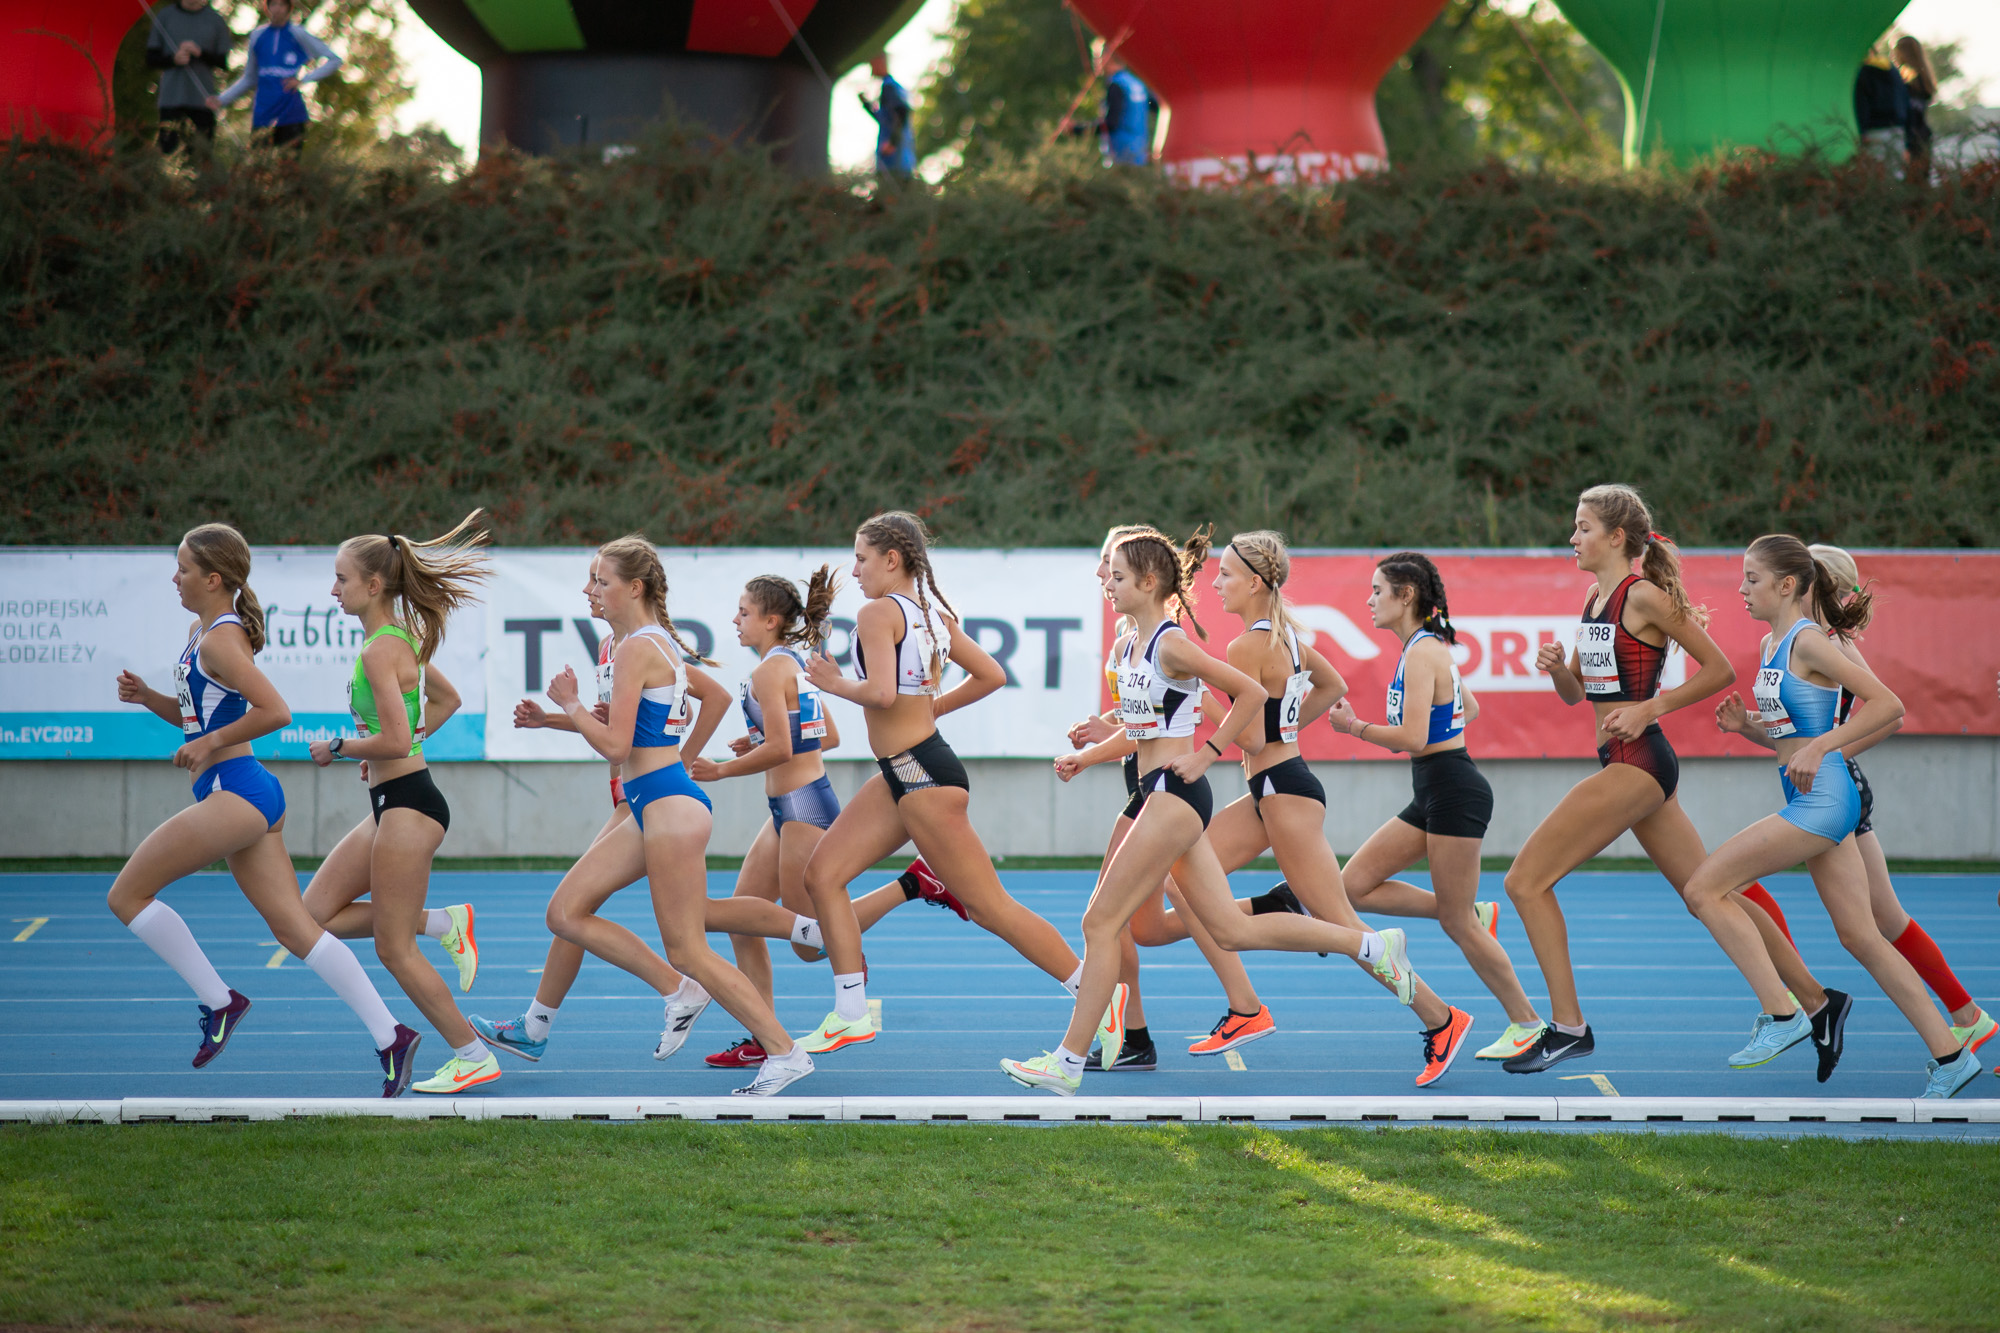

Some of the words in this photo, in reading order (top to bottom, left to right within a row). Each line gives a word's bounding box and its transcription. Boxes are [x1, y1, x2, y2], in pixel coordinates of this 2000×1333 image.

[0, 622, 62, 640] OLICA
[1589, 626, 1611, 641] 998
[1129, 729, 1146, 738] 2022
